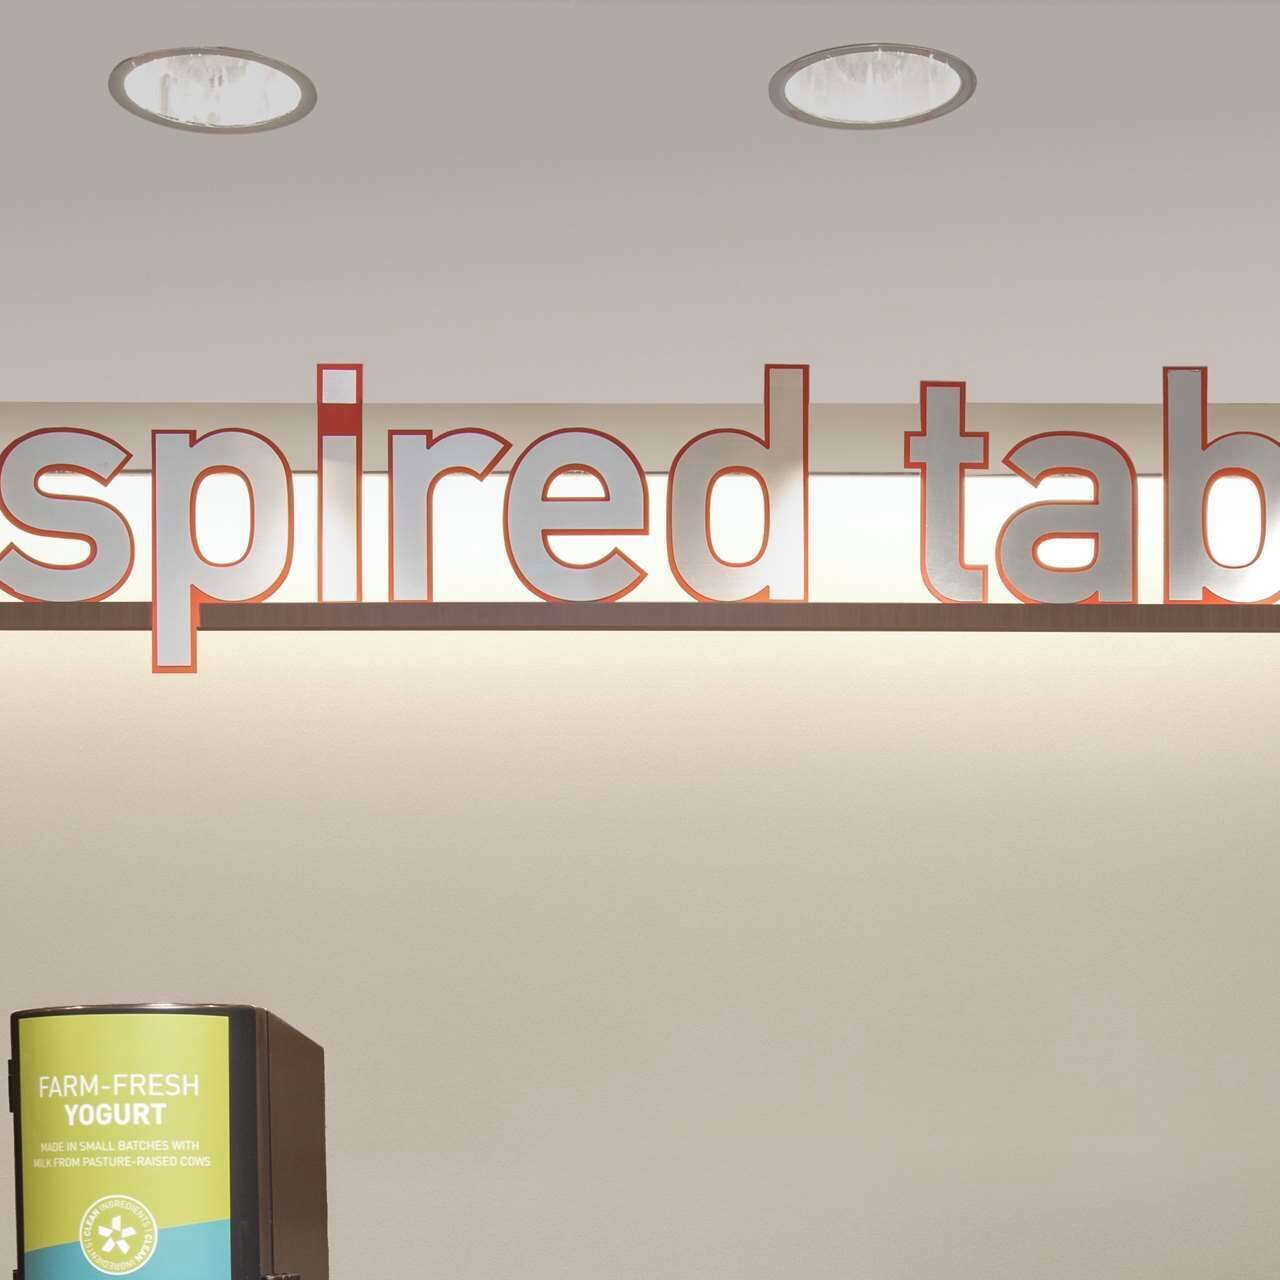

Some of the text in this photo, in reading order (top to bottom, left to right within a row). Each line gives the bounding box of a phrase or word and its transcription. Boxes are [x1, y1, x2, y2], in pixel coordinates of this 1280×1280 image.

[39, 1073, 200, 1098] FARM-FRESH
[63, 1103, 167, 1127] YOGURT
[40, 1140, 200, 1153] MADE IN SMALL BATCHES WITH
[53, 1157, 80, 1168] FROM
[82, 1156, 177, 1168] PASTURE-RAISED
[179, 1156, 212, 1167] COWS
